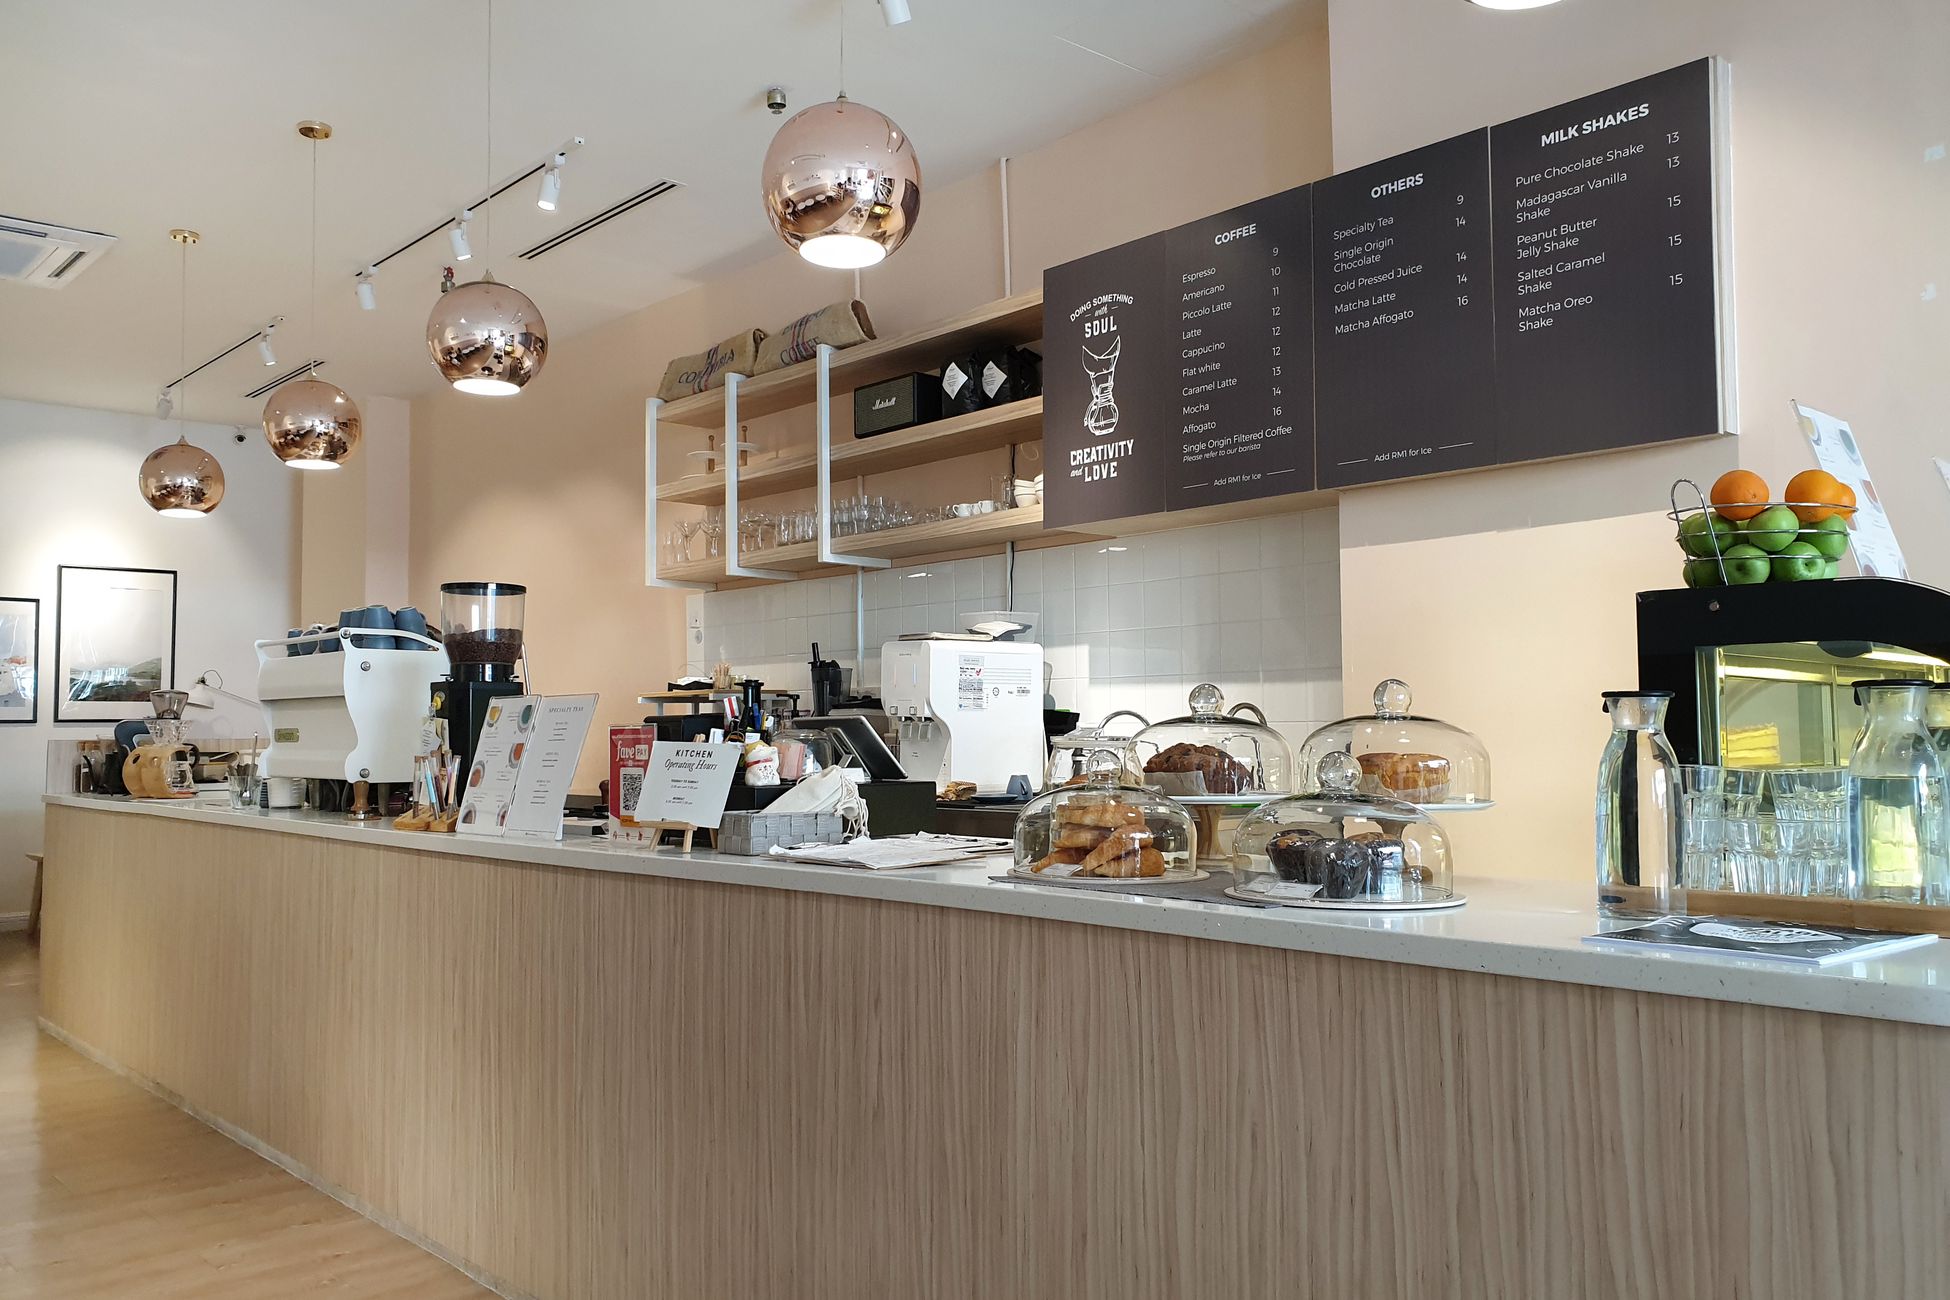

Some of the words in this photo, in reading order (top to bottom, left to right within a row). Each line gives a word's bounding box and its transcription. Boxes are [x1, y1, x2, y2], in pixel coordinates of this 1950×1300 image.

[1541, 125, 1580, 147] MILK
[1582, 103, 1650, 135] SHAKES
[1667, 131, 1680, 145] 13
[1515, 172, 1542, 188] Pure
[1544, 154, 1604, 179] Chocolate
[1607, 143, 1645, 162] Shake
[1667, 156, 1681, 169] 13
[1371, 173, 1424, 199] OTHERS
[1517, 183, 1585, 210] Madagascar
[1588, 171, 1628, 191] Vanilla
[1457, 195, 1464, 205] 9
[1668, 195, 1682, 208] 15
[1456, 217, 1466, 227] 14
[1517, 206, 1551, 224] Shake
[1215, 223, 1257, 245] COFFEE
[1333, 221, 1376, 241] Specialty
[1378, 216, 1394, 228] Tea
[1517, 228, 1558, 246] Peanut
[1560, 217, 1598, 235] Butter
[1517, 243, 1541, 260] Jelly
[1544, 236, 1580, 253] Shake
[1668, 234, 1682, 247] 15
[1273, 248, 1279, 256] 9
[1334, 245, 1362, 261] Single
[1365, 237, 1394, 253] Origin
[1334, 254, 1381, 273] Chocolate
[1456, 252, 1467, 263] 14
[1271, 267, 1281, 276] 10
[1518, 264, 1553, 282] Salted
[1556, 252, 1606, 273] Caramel
[1183, 268, 1216, 283] Espresso
[1334, 279, 1356, 294] Cold
[1358, 270, 1395, 288] Pressed
[1397, 264, 1423, 279] Juice
[1457, 274, 1468, 284] 14
[1669, 274, 1683, 286] 15
[1182, 284, 1225, 302] Americano
[1273, 287, 1279, 296] 11
[1518, 279, 1553, 296] Shake
[1070, 302, 1092, 322] DOING
[1093, 294, 1134, 306] SOMETHING
[1335, 298, 1370, 314] Matcha
[1372, 292, 1396, 305] Latte
[1458, 296, 1468, 306] 16
[1519, 301, 1561, 318] Matcha
[1564, 295, 1593, 310] Oreo
[1095, 304, 1108, 317] with
[1183, 306, 1210, 320] Piccolo
[1212, 301, 1232, 313] Latte
[1272, 307, 1280, 316] 12
[1085, 316, 1117, 339] SOUL
[1335, 318, 1370, 335] Matcha
[1372, 309, 1414, 327] Affogato
[1519, 316, 1554, 332] Shake
[1183, 329, 1202, 340] Latte
[1272, 327, 1281, 336] 12
[1183, 342, 1226, 358] Cappucino
[1273, 347, 1281, 356] 12
[1183, 367, 1197, 378] Flat
[1198, 362, 1221, 374] white
[1273, 367, 1281, 376] 13
[1183, 382, 1215, 396] Caramel
[1217, 378, 1238, 389] Latte
[1273, 387, 1281, 396] 14
[872, 397, 896, 411] Marshall
[1183, 403, 1210, 415] Mocha
[1273, 407, 1282, 416] 16
[1183, 421, 1217, 434] Affogato
[1183, 441, 1207, 454] Single
[1208, 437, 1232, 449] Origin
[1234, 430, 1264, 444] Filtered
[1265, 426, 1293, 438] Coffee
[1070, 439, 1134, 466] CREATIVITY
[1183, 454, 1203, 463] Please
[1204, 450, 1218, 459] refer
[1238, 443, 1261, 453] barista
[1374, 453, 1390, 462] Add
[1392, 451, 1407, 459] RM1
[1409, 449, 1420, 457] for
[1421, 447, 1433, 455] Ice
[1070, 466, 1084, 477] and
[1085, 462, 1118, 483] LOVE
[1214, 479, 1227, 487] Add
[1228, 476, 1241, 484] RM1
[616, 741, 635, 761] fave
[637, 748, 648, 757] PAY
[675, 750, 714, 759] KITCHEN
[665, 759, 694, 772] Operating
[695, 760, 718, 771] Hours
